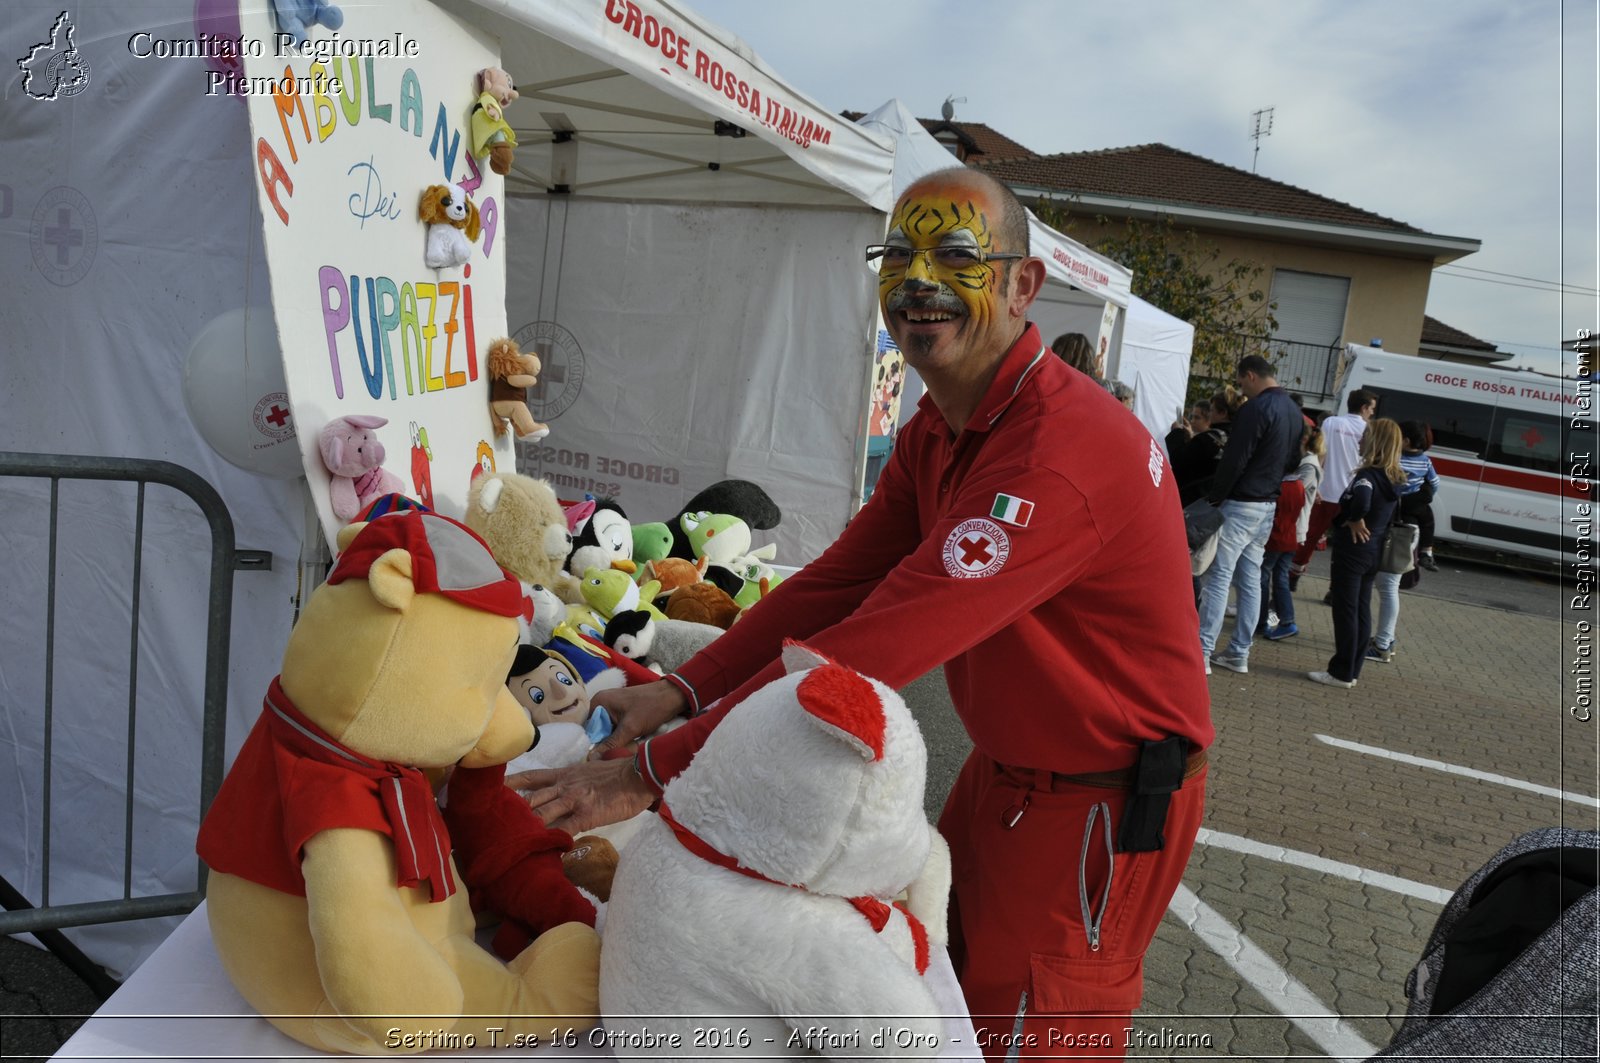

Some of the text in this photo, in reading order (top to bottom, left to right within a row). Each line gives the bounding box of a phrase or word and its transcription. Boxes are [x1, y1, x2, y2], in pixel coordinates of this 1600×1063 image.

[604, 0, 690, 70] CROCE
[694, 49, 760, 119] ROSSA
[765, 97, 832, 146] ITALIANA
[348, 154, 401, 230] Dei
[318, 263, 478, 400] PUPAZZI
[1425, 373, 1582, 406] CROCE ROSSA ITALIANA
[943, 539, 954, 554] 1864
[957, 521, 1007, 544] CONVENZIONE
